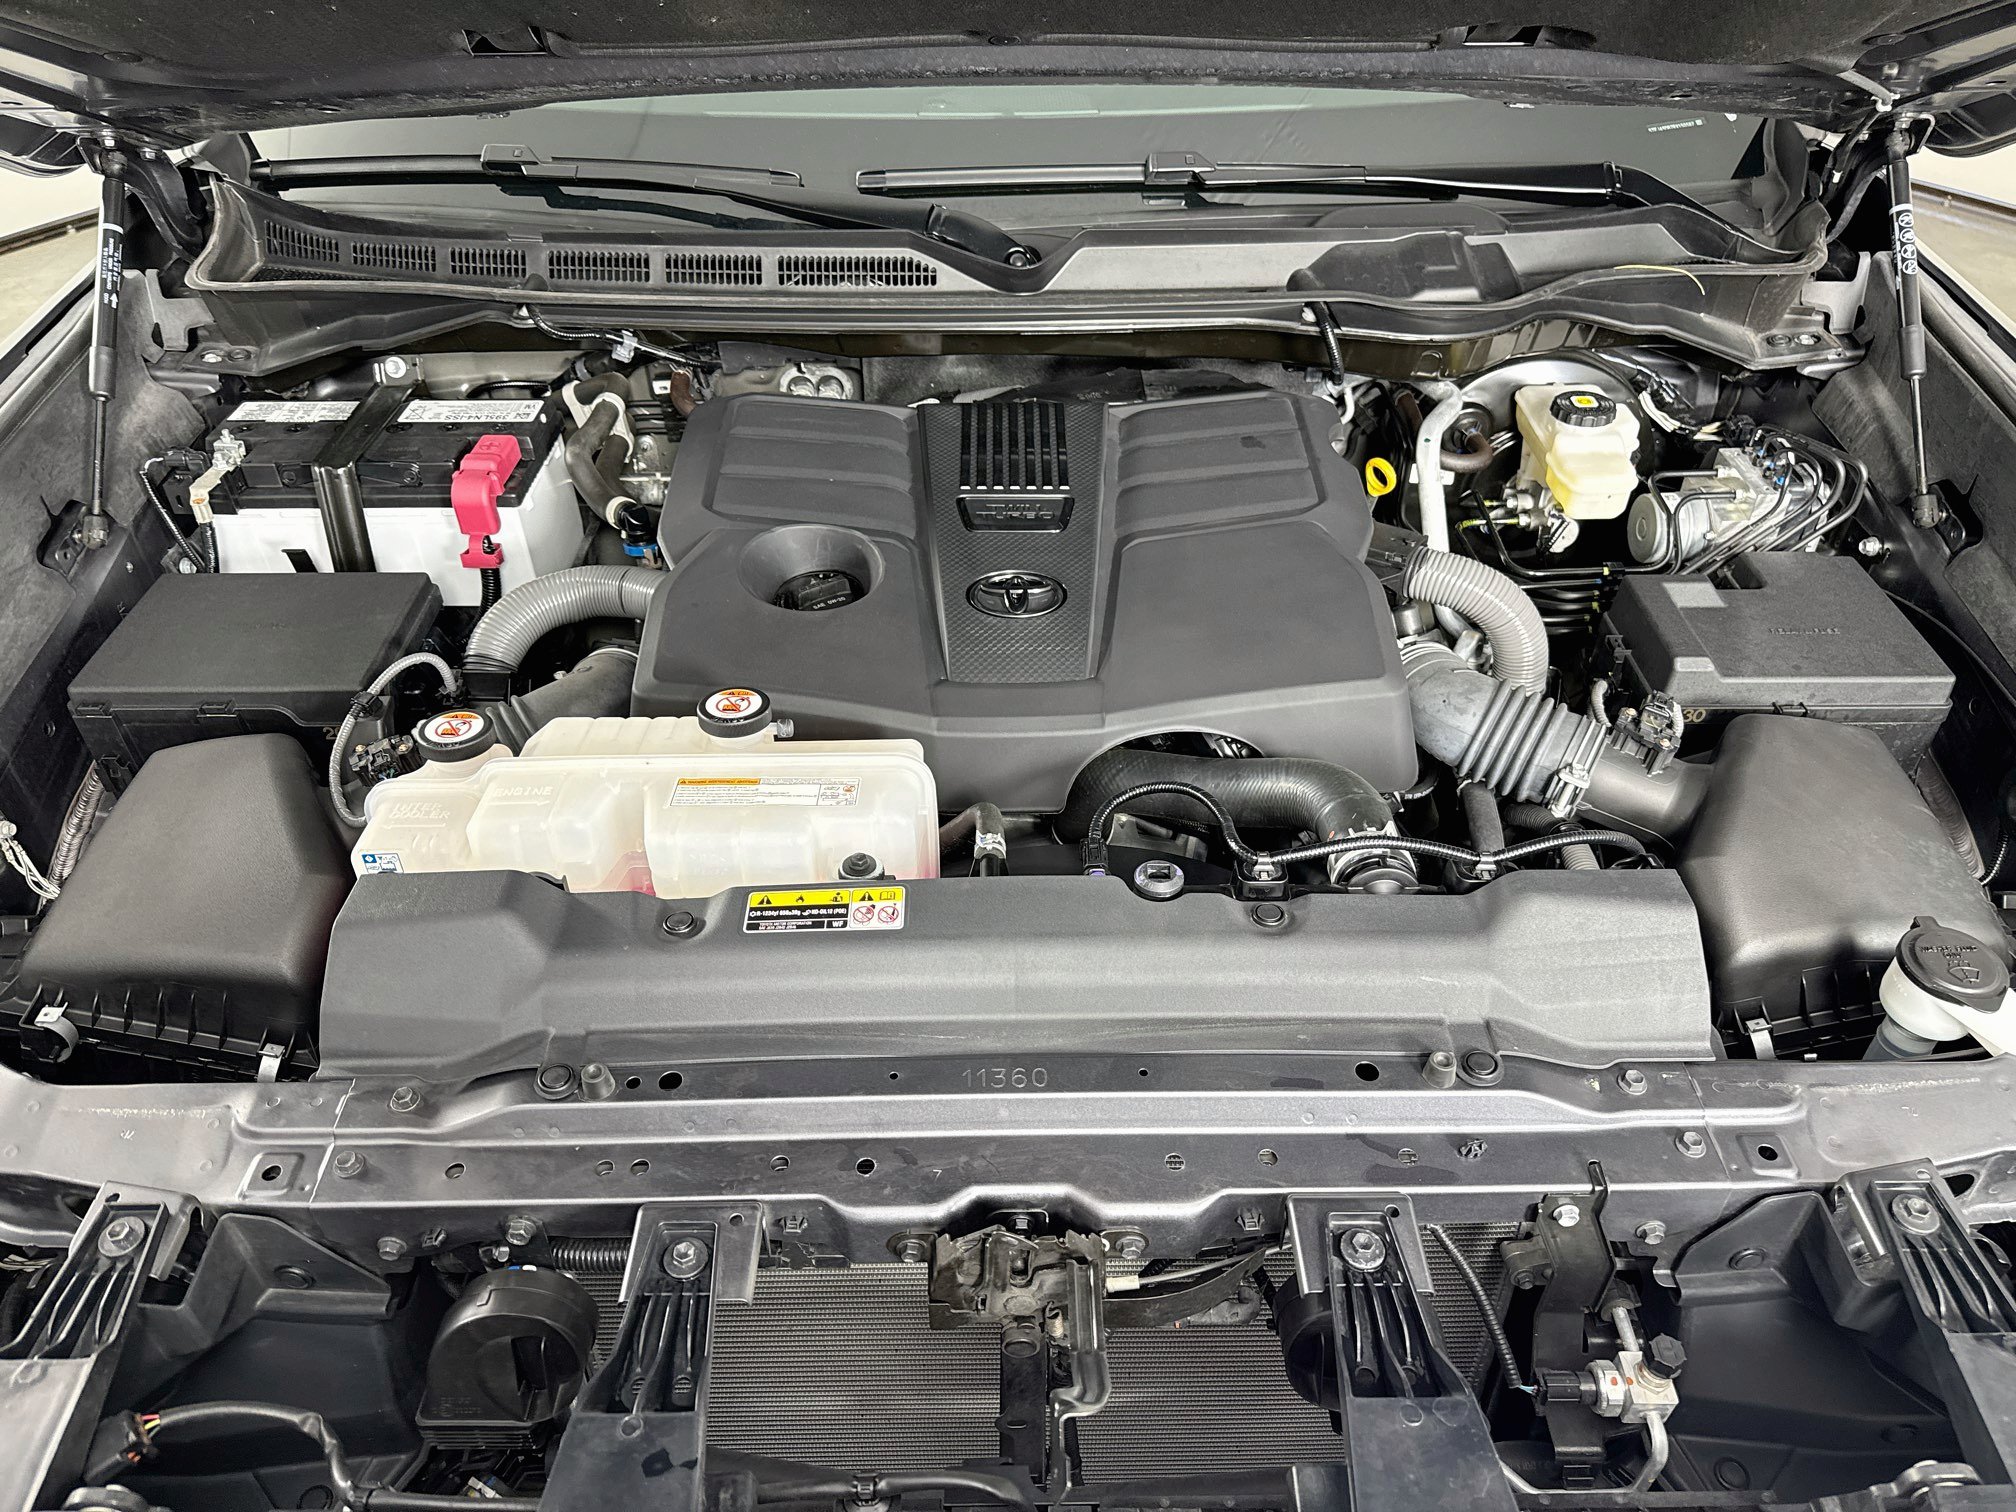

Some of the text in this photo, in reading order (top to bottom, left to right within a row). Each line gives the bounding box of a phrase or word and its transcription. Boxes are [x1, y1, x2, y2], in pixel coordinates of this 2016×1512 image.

[975, 511, 1055, 519] TURBO
[1683, 708, 1707, 723] 30
[493, 786, 554, 797] ENGINE
[961, 1067, 1048, 1088] 11360
